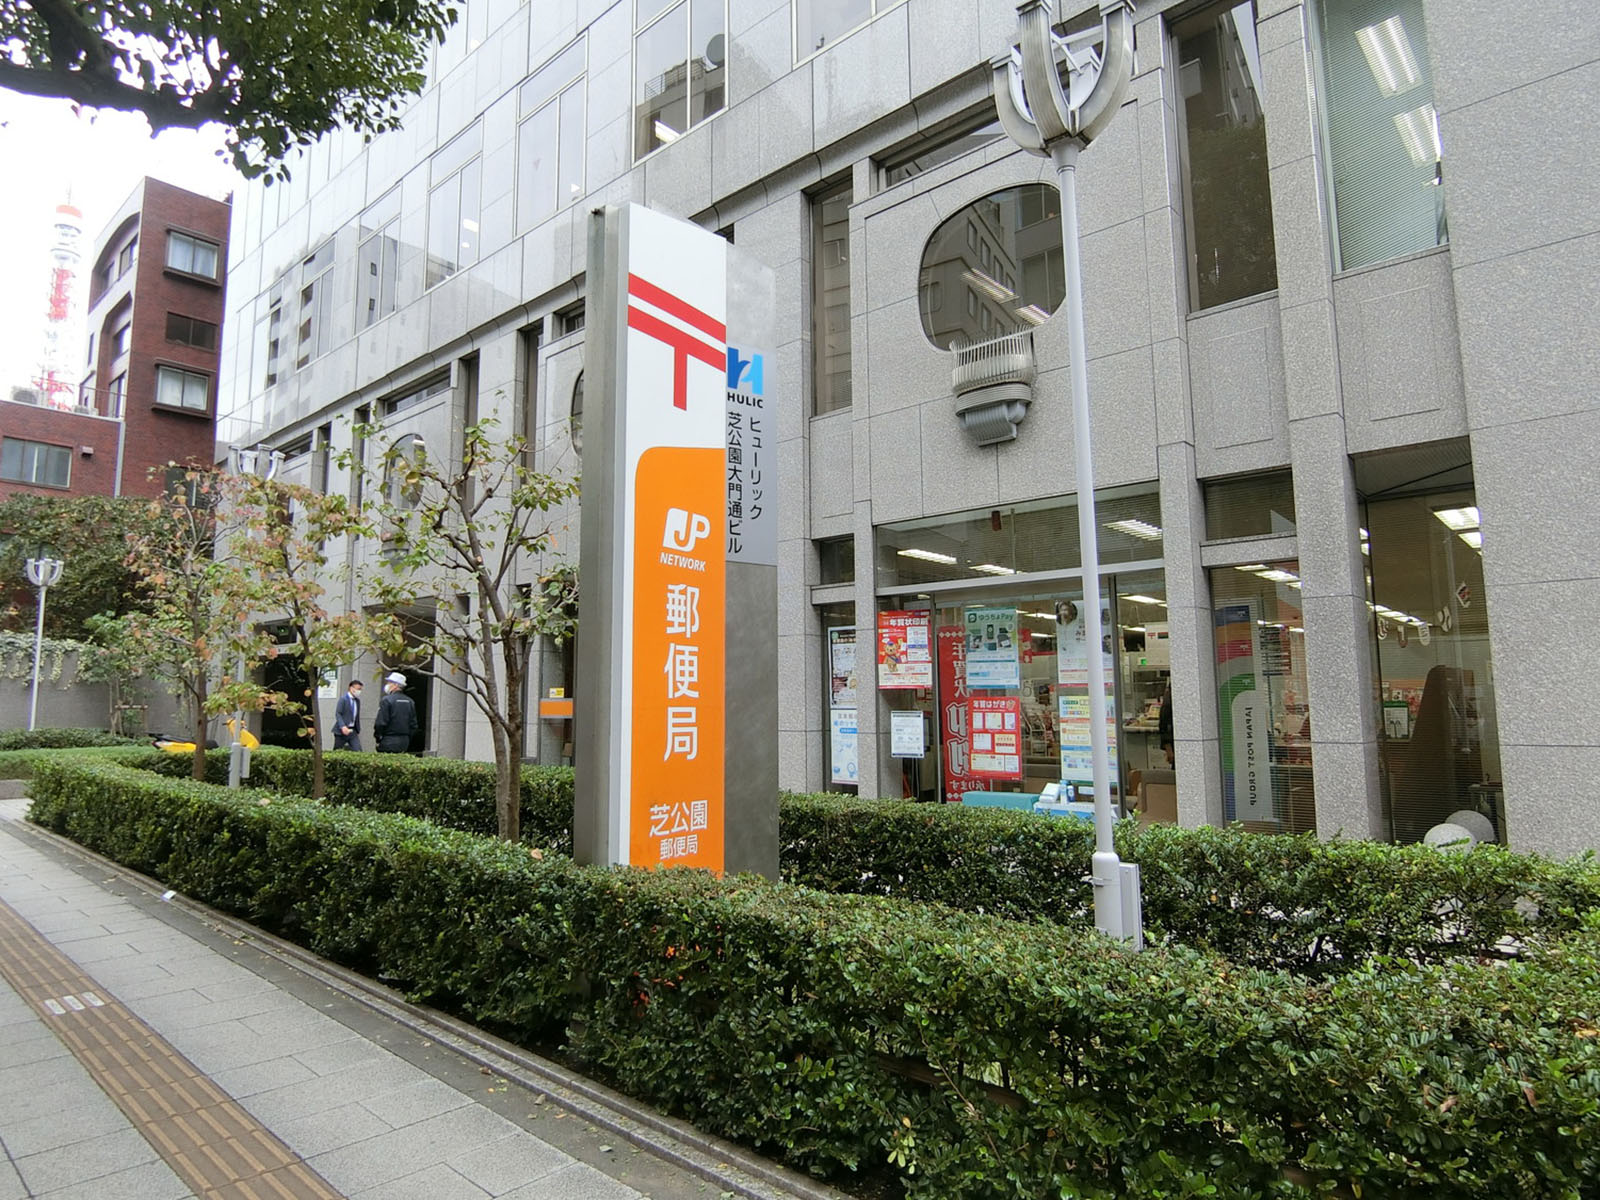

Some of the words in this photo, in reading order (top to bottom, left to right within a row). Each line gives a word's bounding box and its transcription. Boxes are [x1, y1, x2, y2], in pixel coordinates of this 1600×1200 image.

[727, 392, 764, 409] HULIC
[728, 411, 743, 554] 芝公園大門通ビル
[750, 416, 763, 520] ヒューリック
[659, 552, 707, 572] NETWORK
[663, 583, 700, 762] 郵便局
[649, 800, 708, 838] 芝公園
[659, 834, 698, 860] 郵便局
